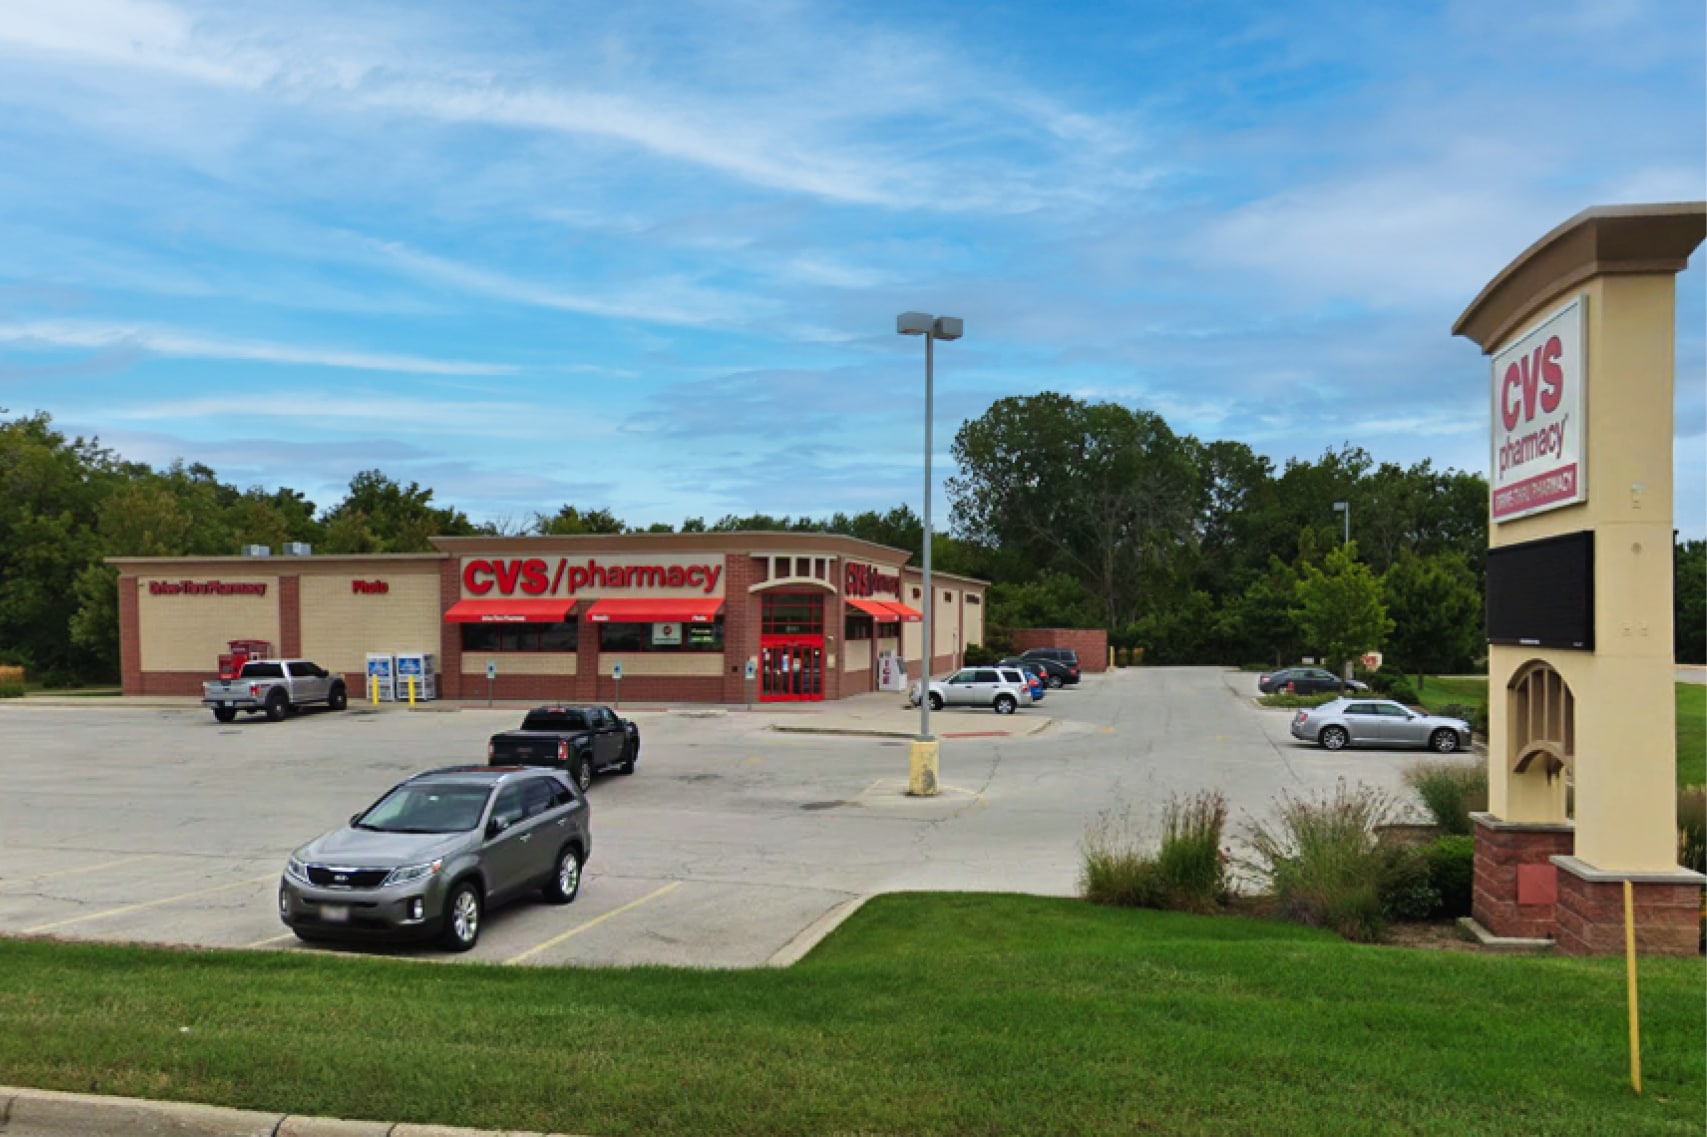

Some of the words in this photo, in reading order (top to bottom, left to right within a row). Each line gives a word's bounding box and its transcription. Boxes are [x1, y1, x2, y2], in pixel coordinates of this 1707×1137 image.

[1502, 336, 1563, 431] CVS
[1499, 419, 1566, 479] pharmacy
[352, 579, 389, 595] Photo
